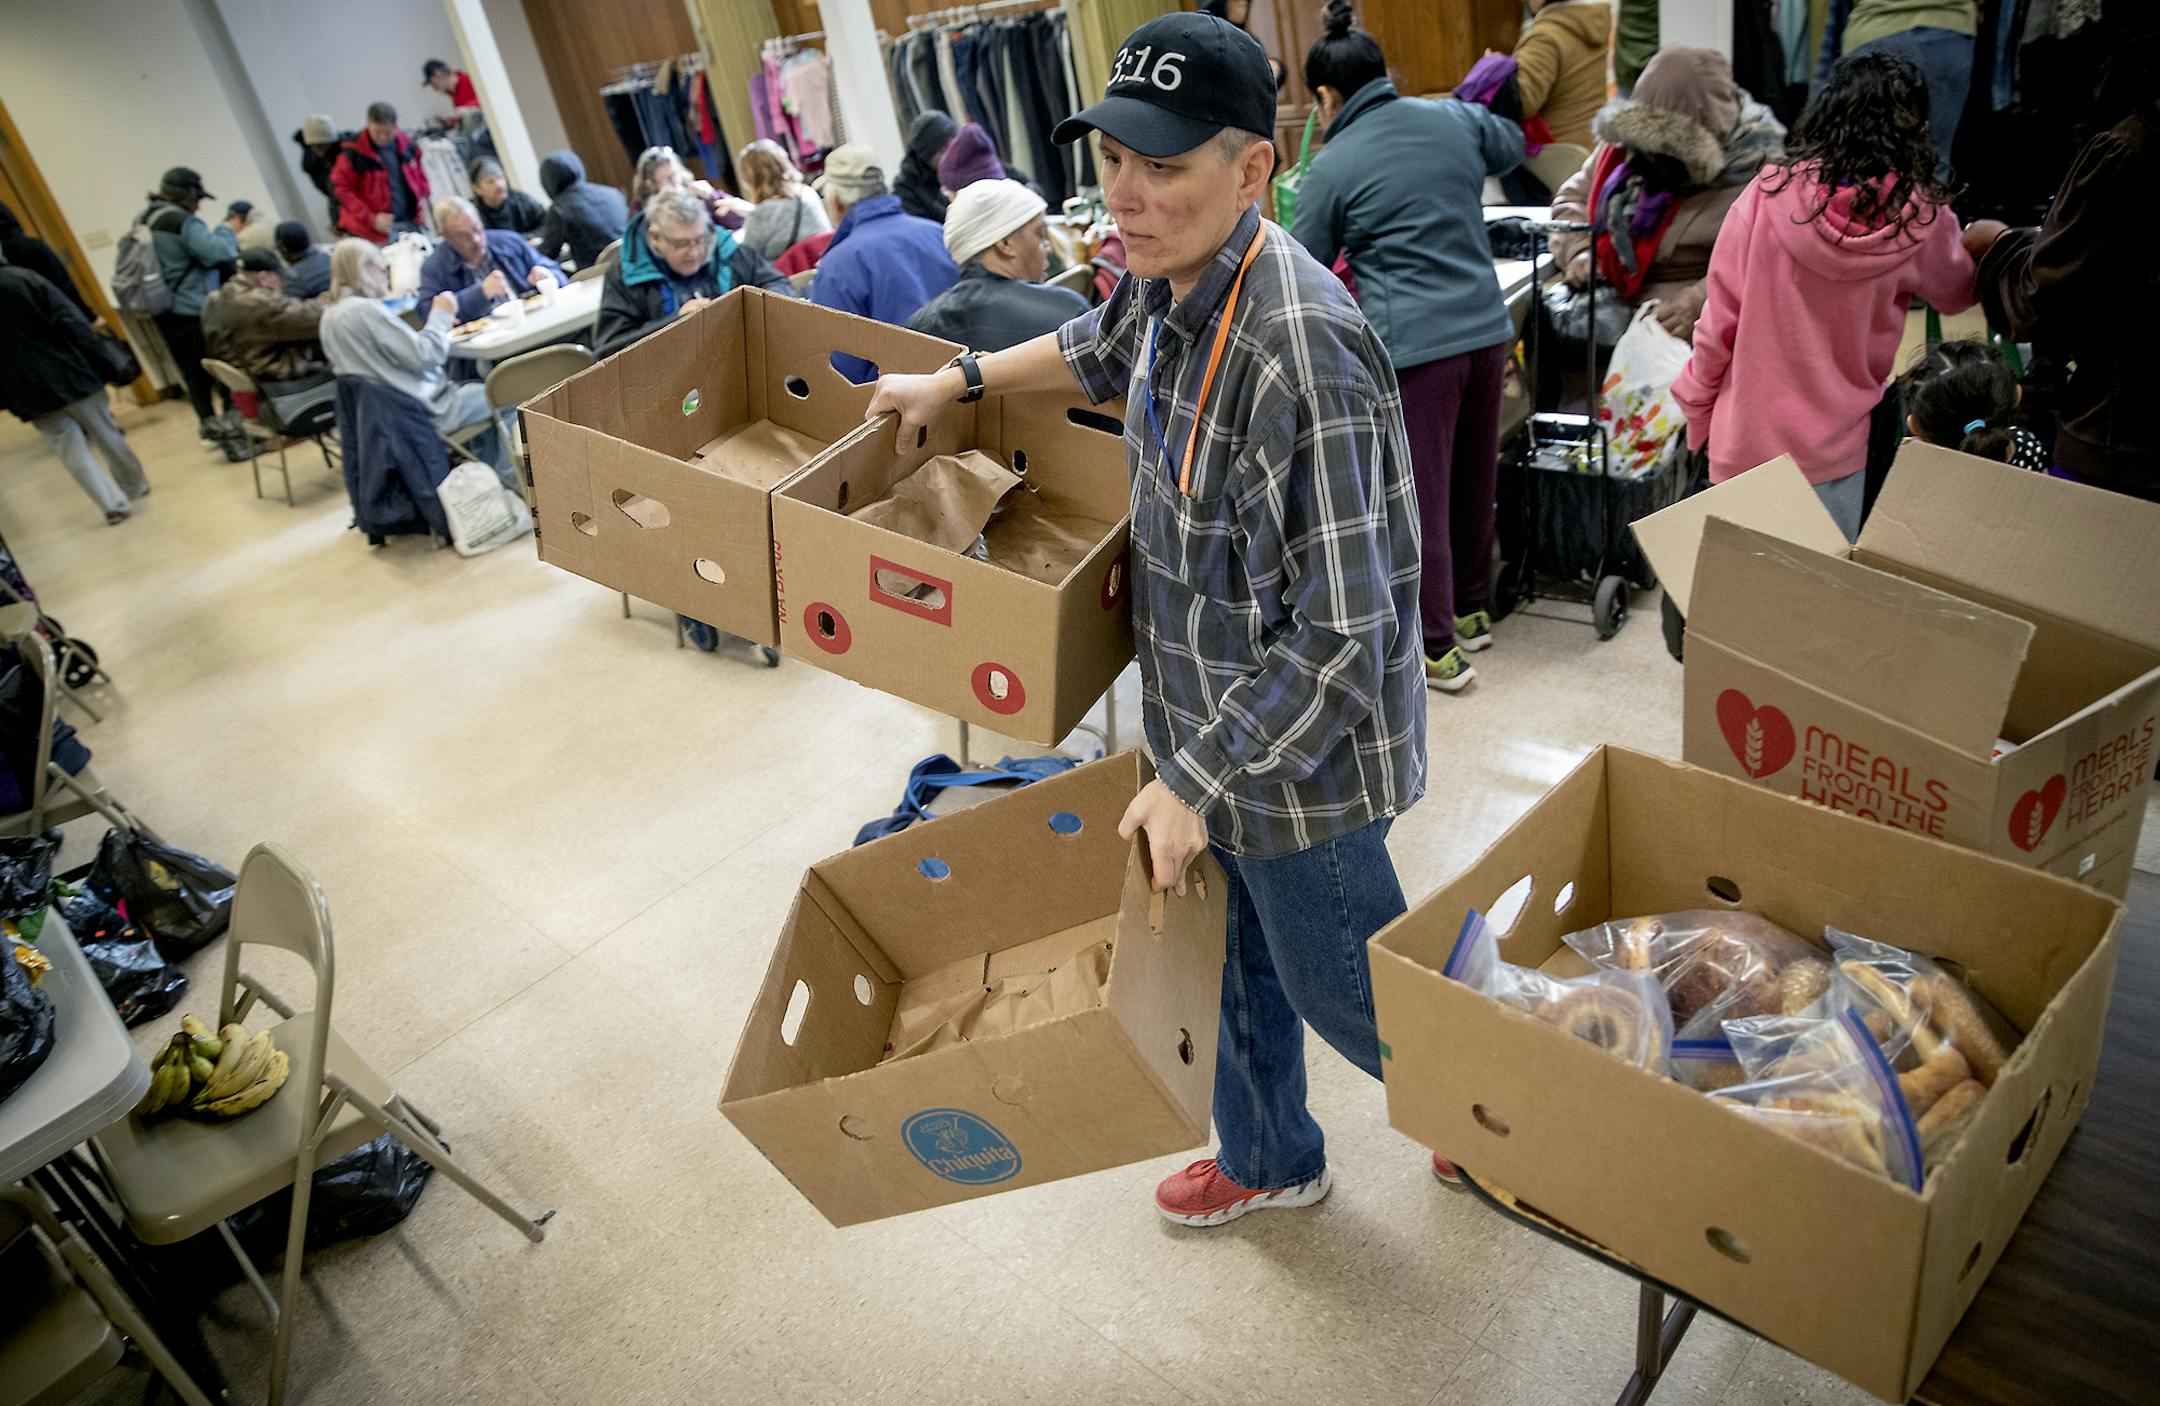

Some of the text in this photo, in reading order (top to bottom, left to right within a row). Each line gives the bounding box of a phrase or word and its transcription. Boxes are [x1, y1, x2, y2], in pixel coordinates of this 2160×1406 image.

[1107, 46, 1186, 91] 3:16
[1805, 725, 1949, 813] MEALS
[2070, 741, 2152, 803] FROM THE
[2072, 717, 2156, 785] MEALS
[1803, 756, 1882, 810] FROM
[1889, 795, 1946, 839] THE
[2067, 760, 2149, 831] HEART
[927, 1143, 1017, 1175] Chiquita
